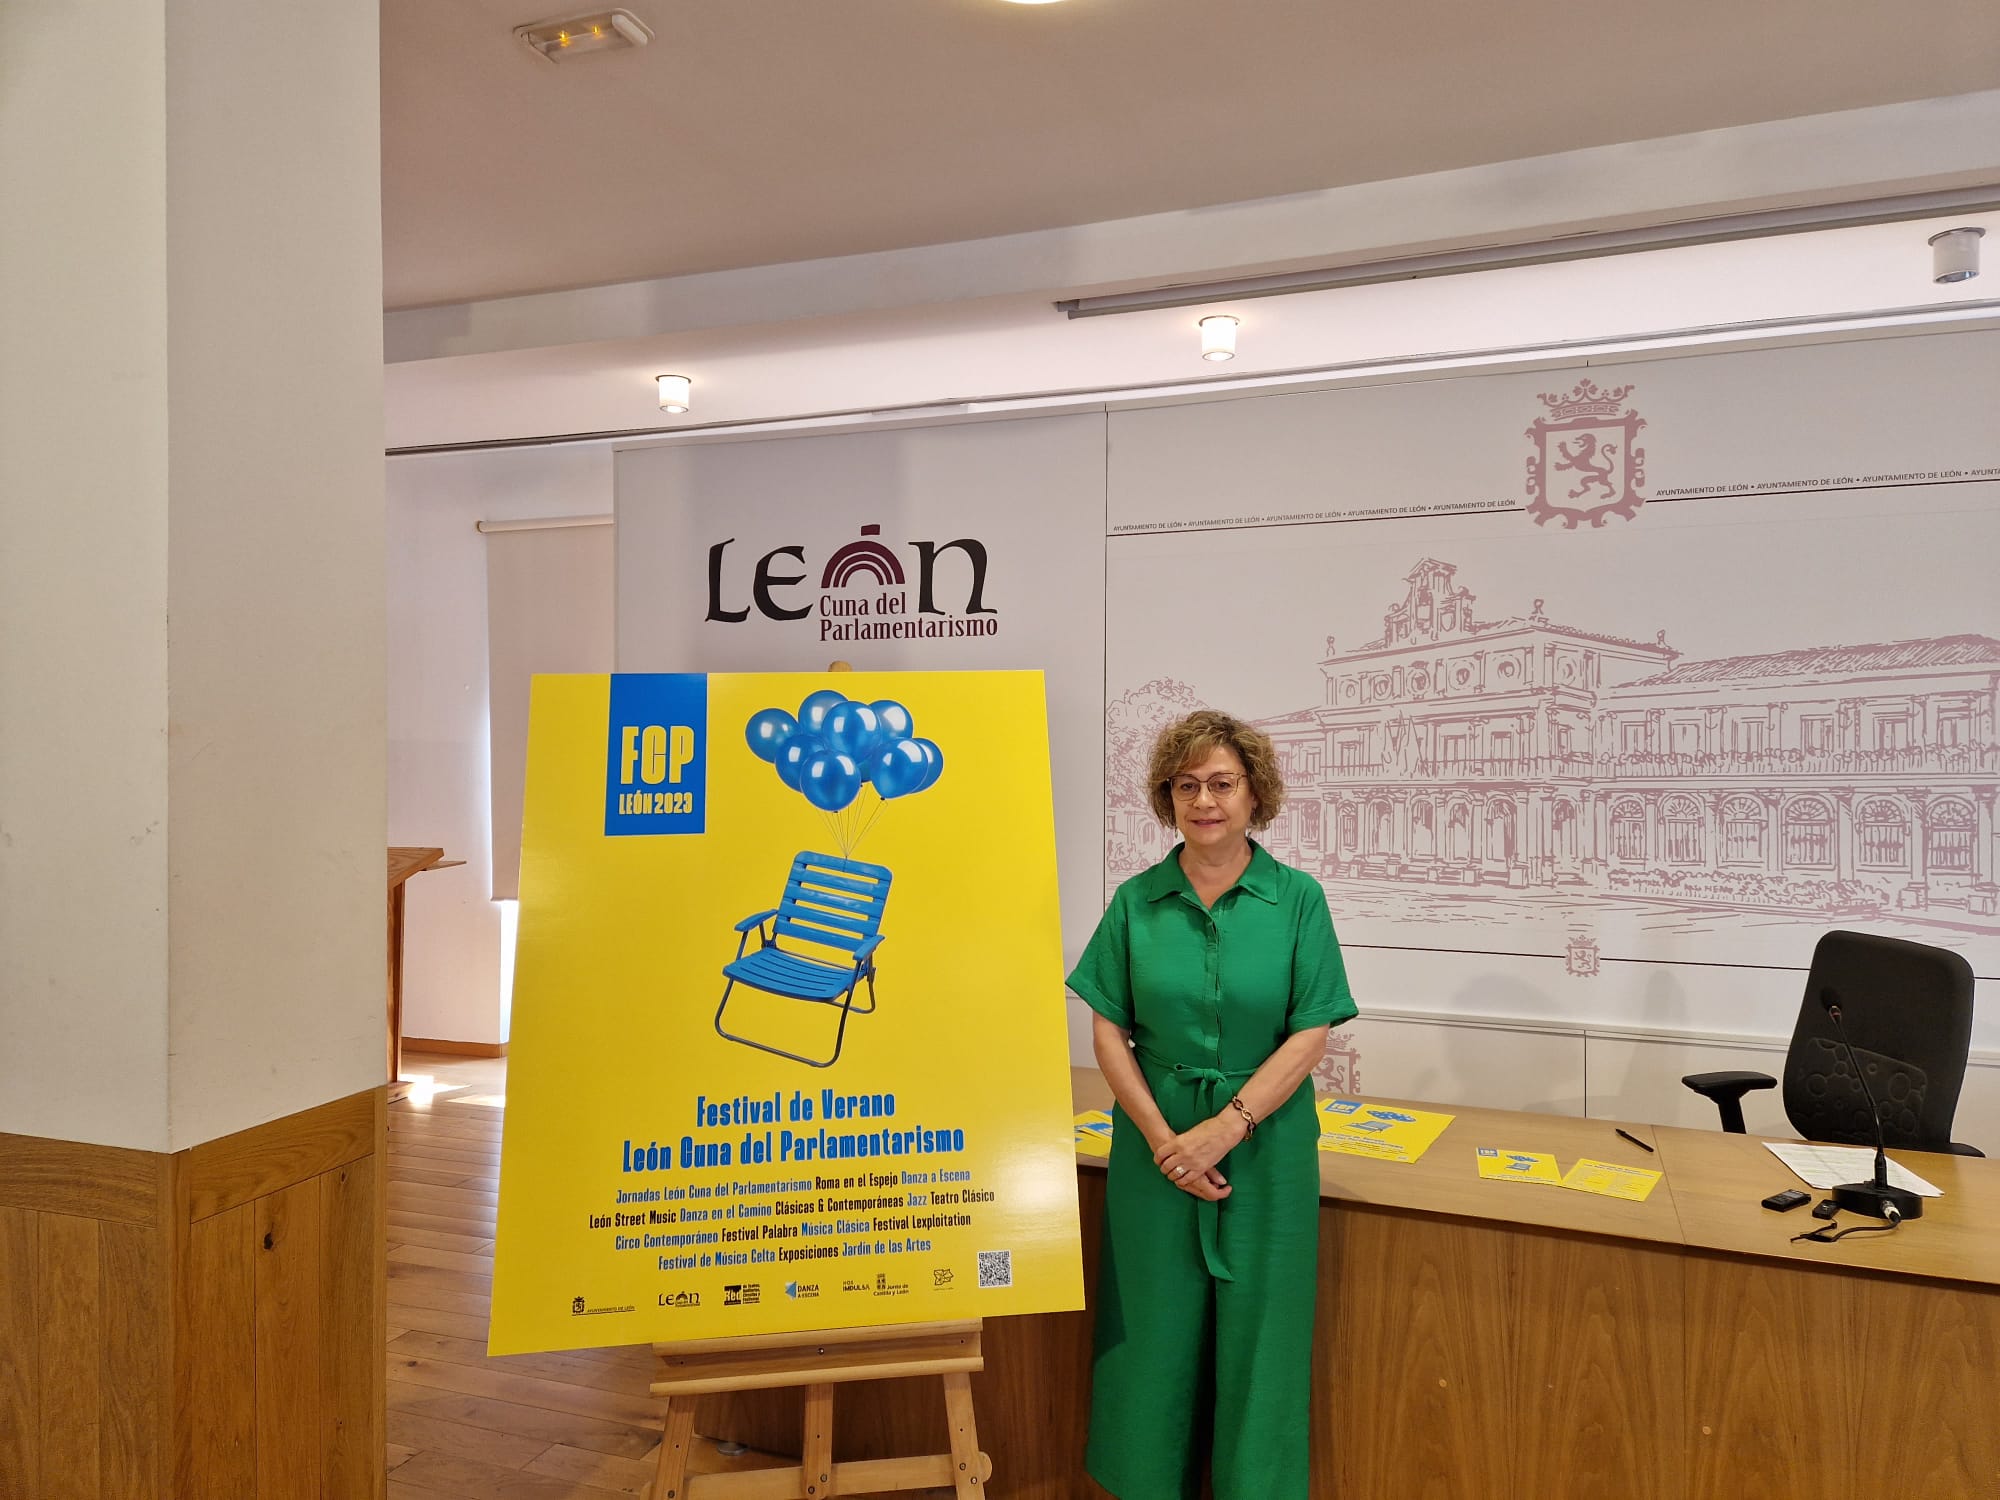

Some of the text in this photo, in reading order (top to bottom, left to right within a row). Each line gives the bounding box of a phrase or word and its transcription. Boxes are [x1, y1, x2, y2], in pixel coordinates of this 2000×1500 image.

[1656, 486, 1714, 496] AYUNTAMIENTO
[1728, 483, 1749, 492] LEÓN
[1757, 479, 1818, 490] AYUNTAMIENTO
[1820, 478, 1830, 486] DE
[1832, 476, 1854, 485] LEÓN
[1862, 472, 1926, 483] AYUNTAMIENTO
[1928, 471, 1938, 479] DE
[1940, 470, 1962, 478] LEÓN
[1113, 522, 1157, 532] AYUNTAMIENTO
[1158, 522, 1166, 530] DE
[1167, 520, 1182, 528] LEÓN
[1188, 518, 1234, 527] AYUNTAMIENTO
[1244, 516, 1260, 524] LEÓN
[1266, 513, 1314, 522] AYUNTAMIENTO
[1325, 510, 1342, 518] LEÓN
[1348, 508, 1398, 517] AYUNTAMIENTO
[1399, 506, 1408, 514] DE
[1409, 504, 1426, 513] LEÓN
[1433, 501, 1486, 511] AYUNTAMIENTO
[1497, 498, 1516, 508] LEÓN
[820, 592, 906, 617] Cuna del
[819, 615, 998, 641] Parlamentarismo
[620, 725, 695, 785] FCP
[619, 789, 693, 815] LEÓN 2023
[696, 1089, 895, 1128] Festival de Verano
[622, 1125, 965, 1173] León Cuna del Parlamentarismo
[615, 1168, 970, 1204] Jornadas León Cuna del Parlamentarismo Roma en el Espejo Danza a Escena
[589, 1214, 612, 1229] León
[615, 1212, 646, 1227] Street
[649, 1209, 677, 1225] Music
[680, 1208, 708, 1222] Danza
[712, 1208, 722, 1219] en
[726, 1204, 735, 1219] el
[738, 1203, 772, 1218] Camino
[775, 1200, 815, 1216] Clásicas
[828, 1195, 904, 1212] Contemporáneas
[907, 1192, 928, 1206] Jazz
[930, 1191, 959, 1206] Teatro
[962, 1188, 995, 1204] Clásico
[615, 1212, 971, 1250] Circo Contemporáneo Festival Palabra Música Clásica Festival Lexploitation
[658, 1238, 931, 1271] Festival de Música Celta Exposiciones Jardín de las Artes
[798, 1284, 819, 1292] DANZA
